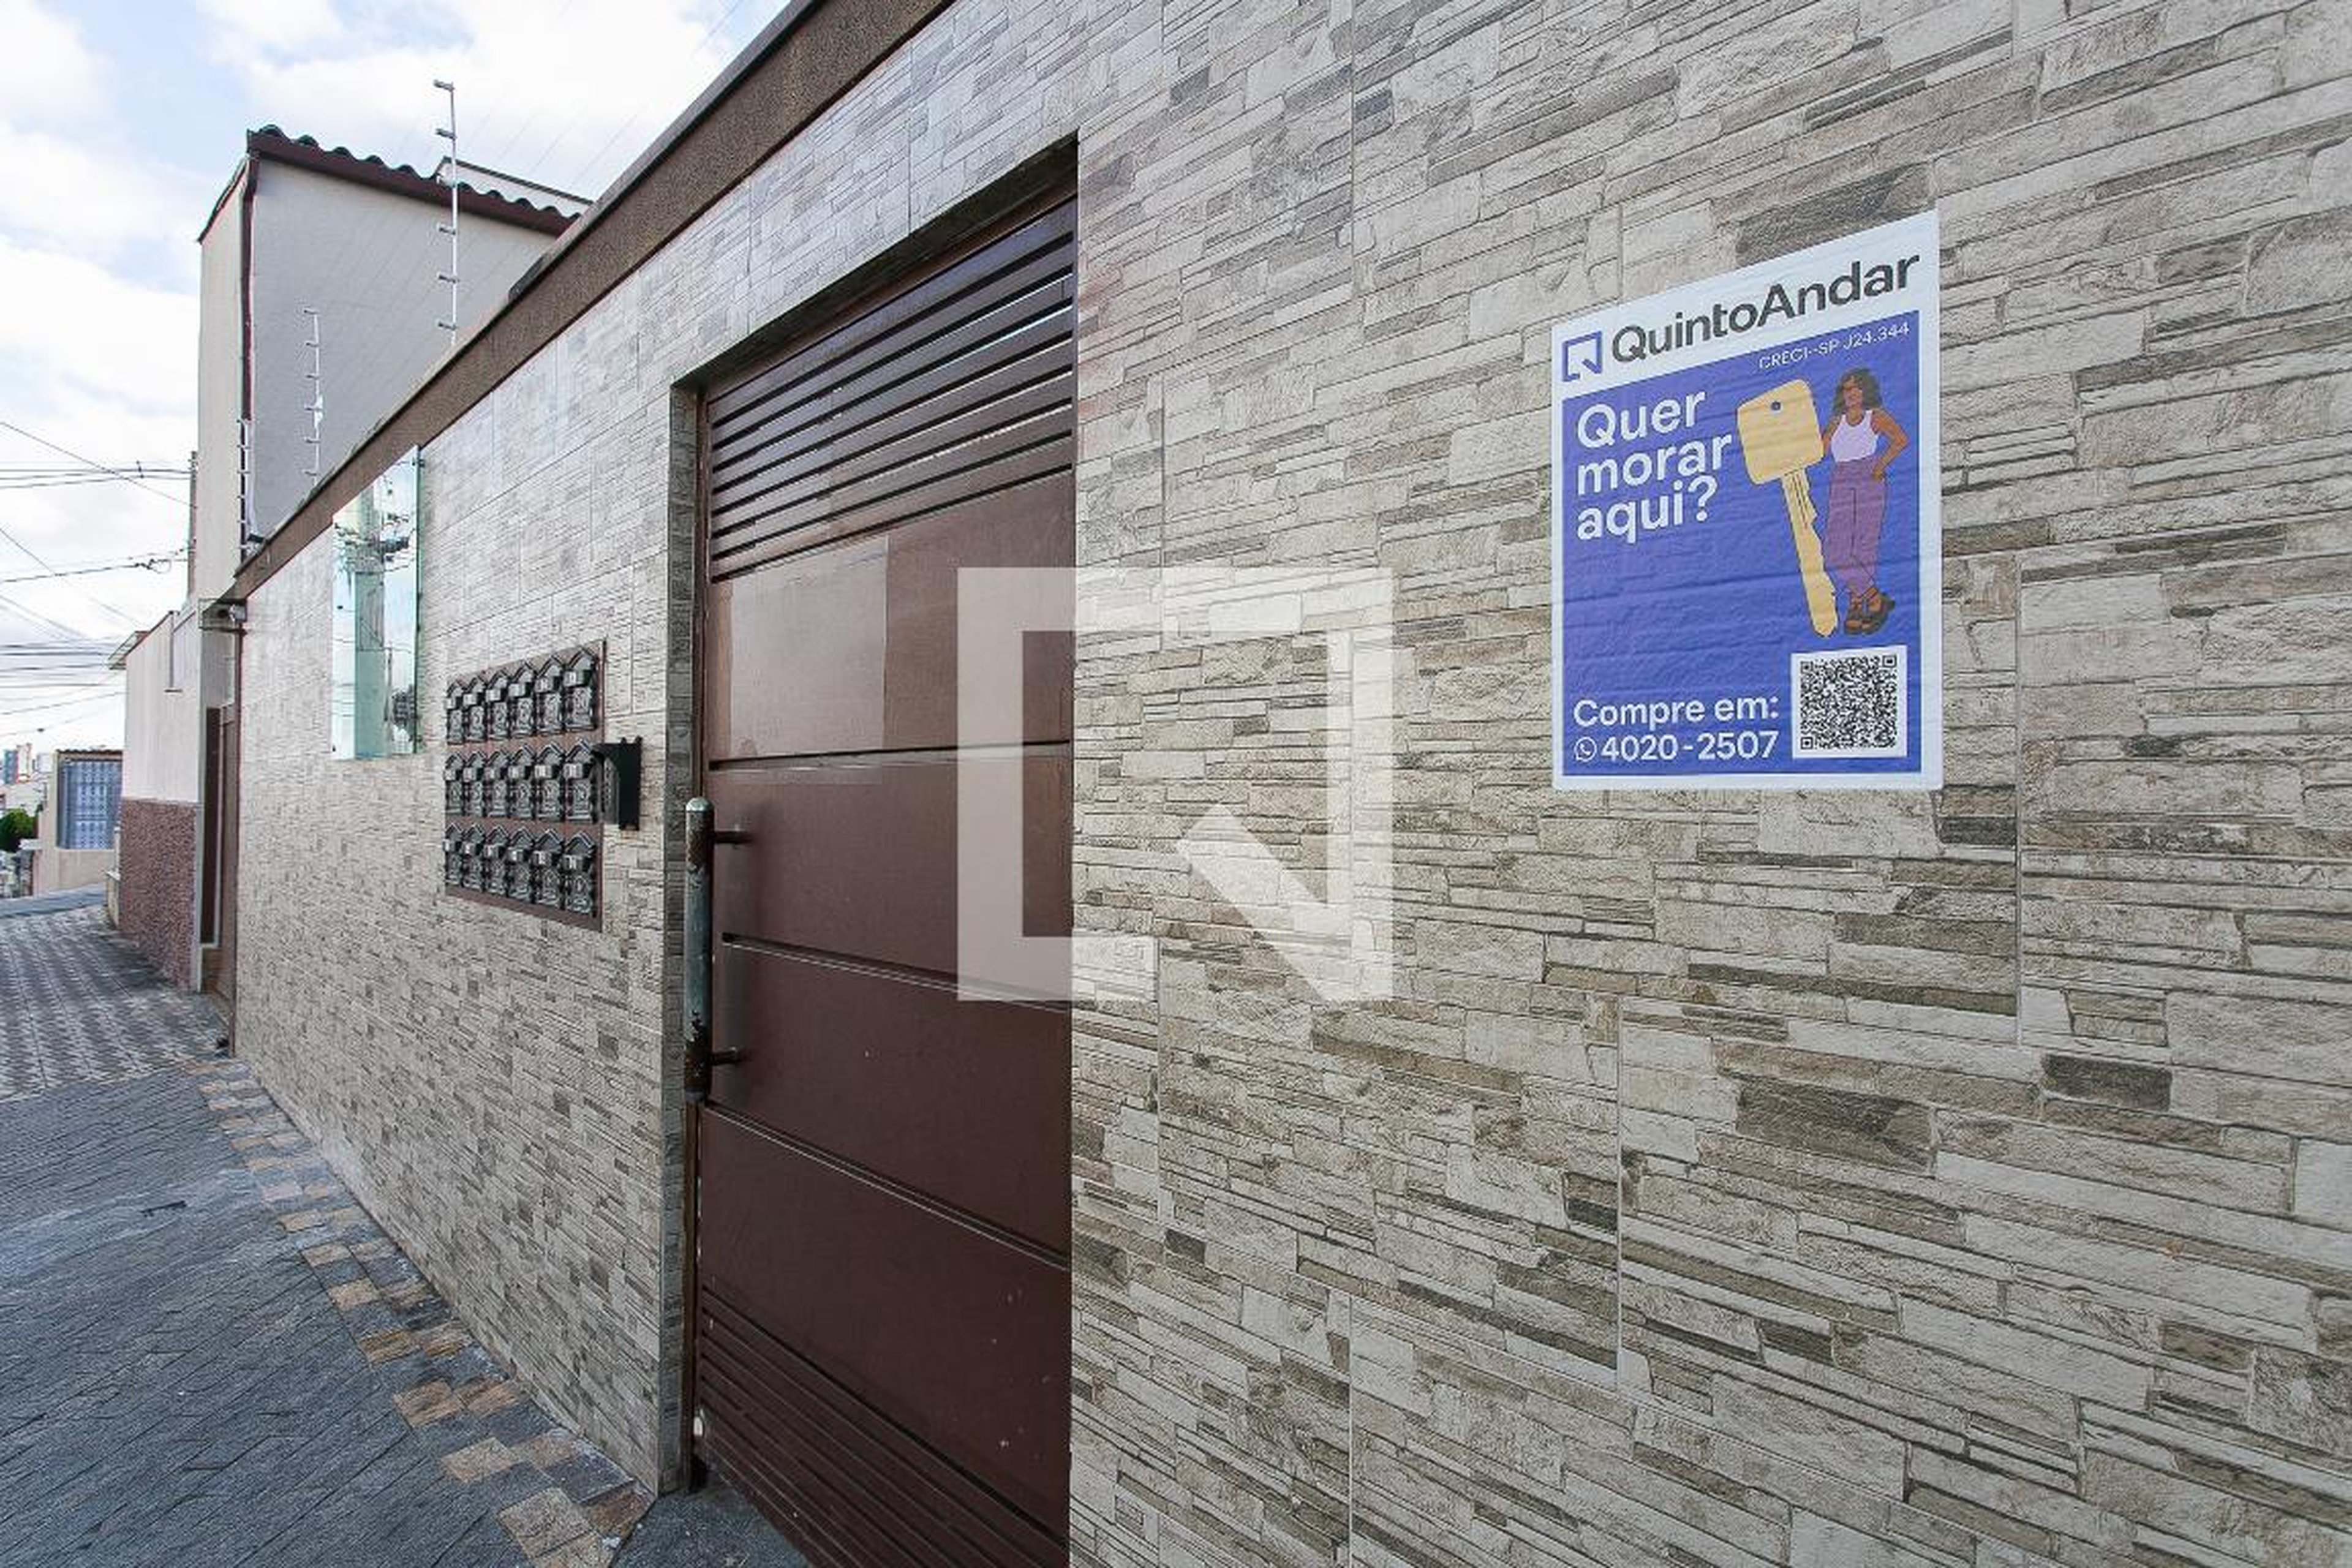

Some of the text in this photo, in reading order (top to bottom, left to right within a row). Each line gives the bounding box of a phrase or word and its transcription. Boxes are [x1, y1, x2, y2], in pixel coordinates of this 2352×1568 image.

[1612, 254, 1920, 363] QuintoAndar
[1844, 322, 1910, 350] J24.344
[1577, 391, 1706, 448] Quer
[1577, 433, 1732, 495] morar
[1577, 475, 1717, 541] aqui?
[1573, 693, 1780, 731] Compre em:
